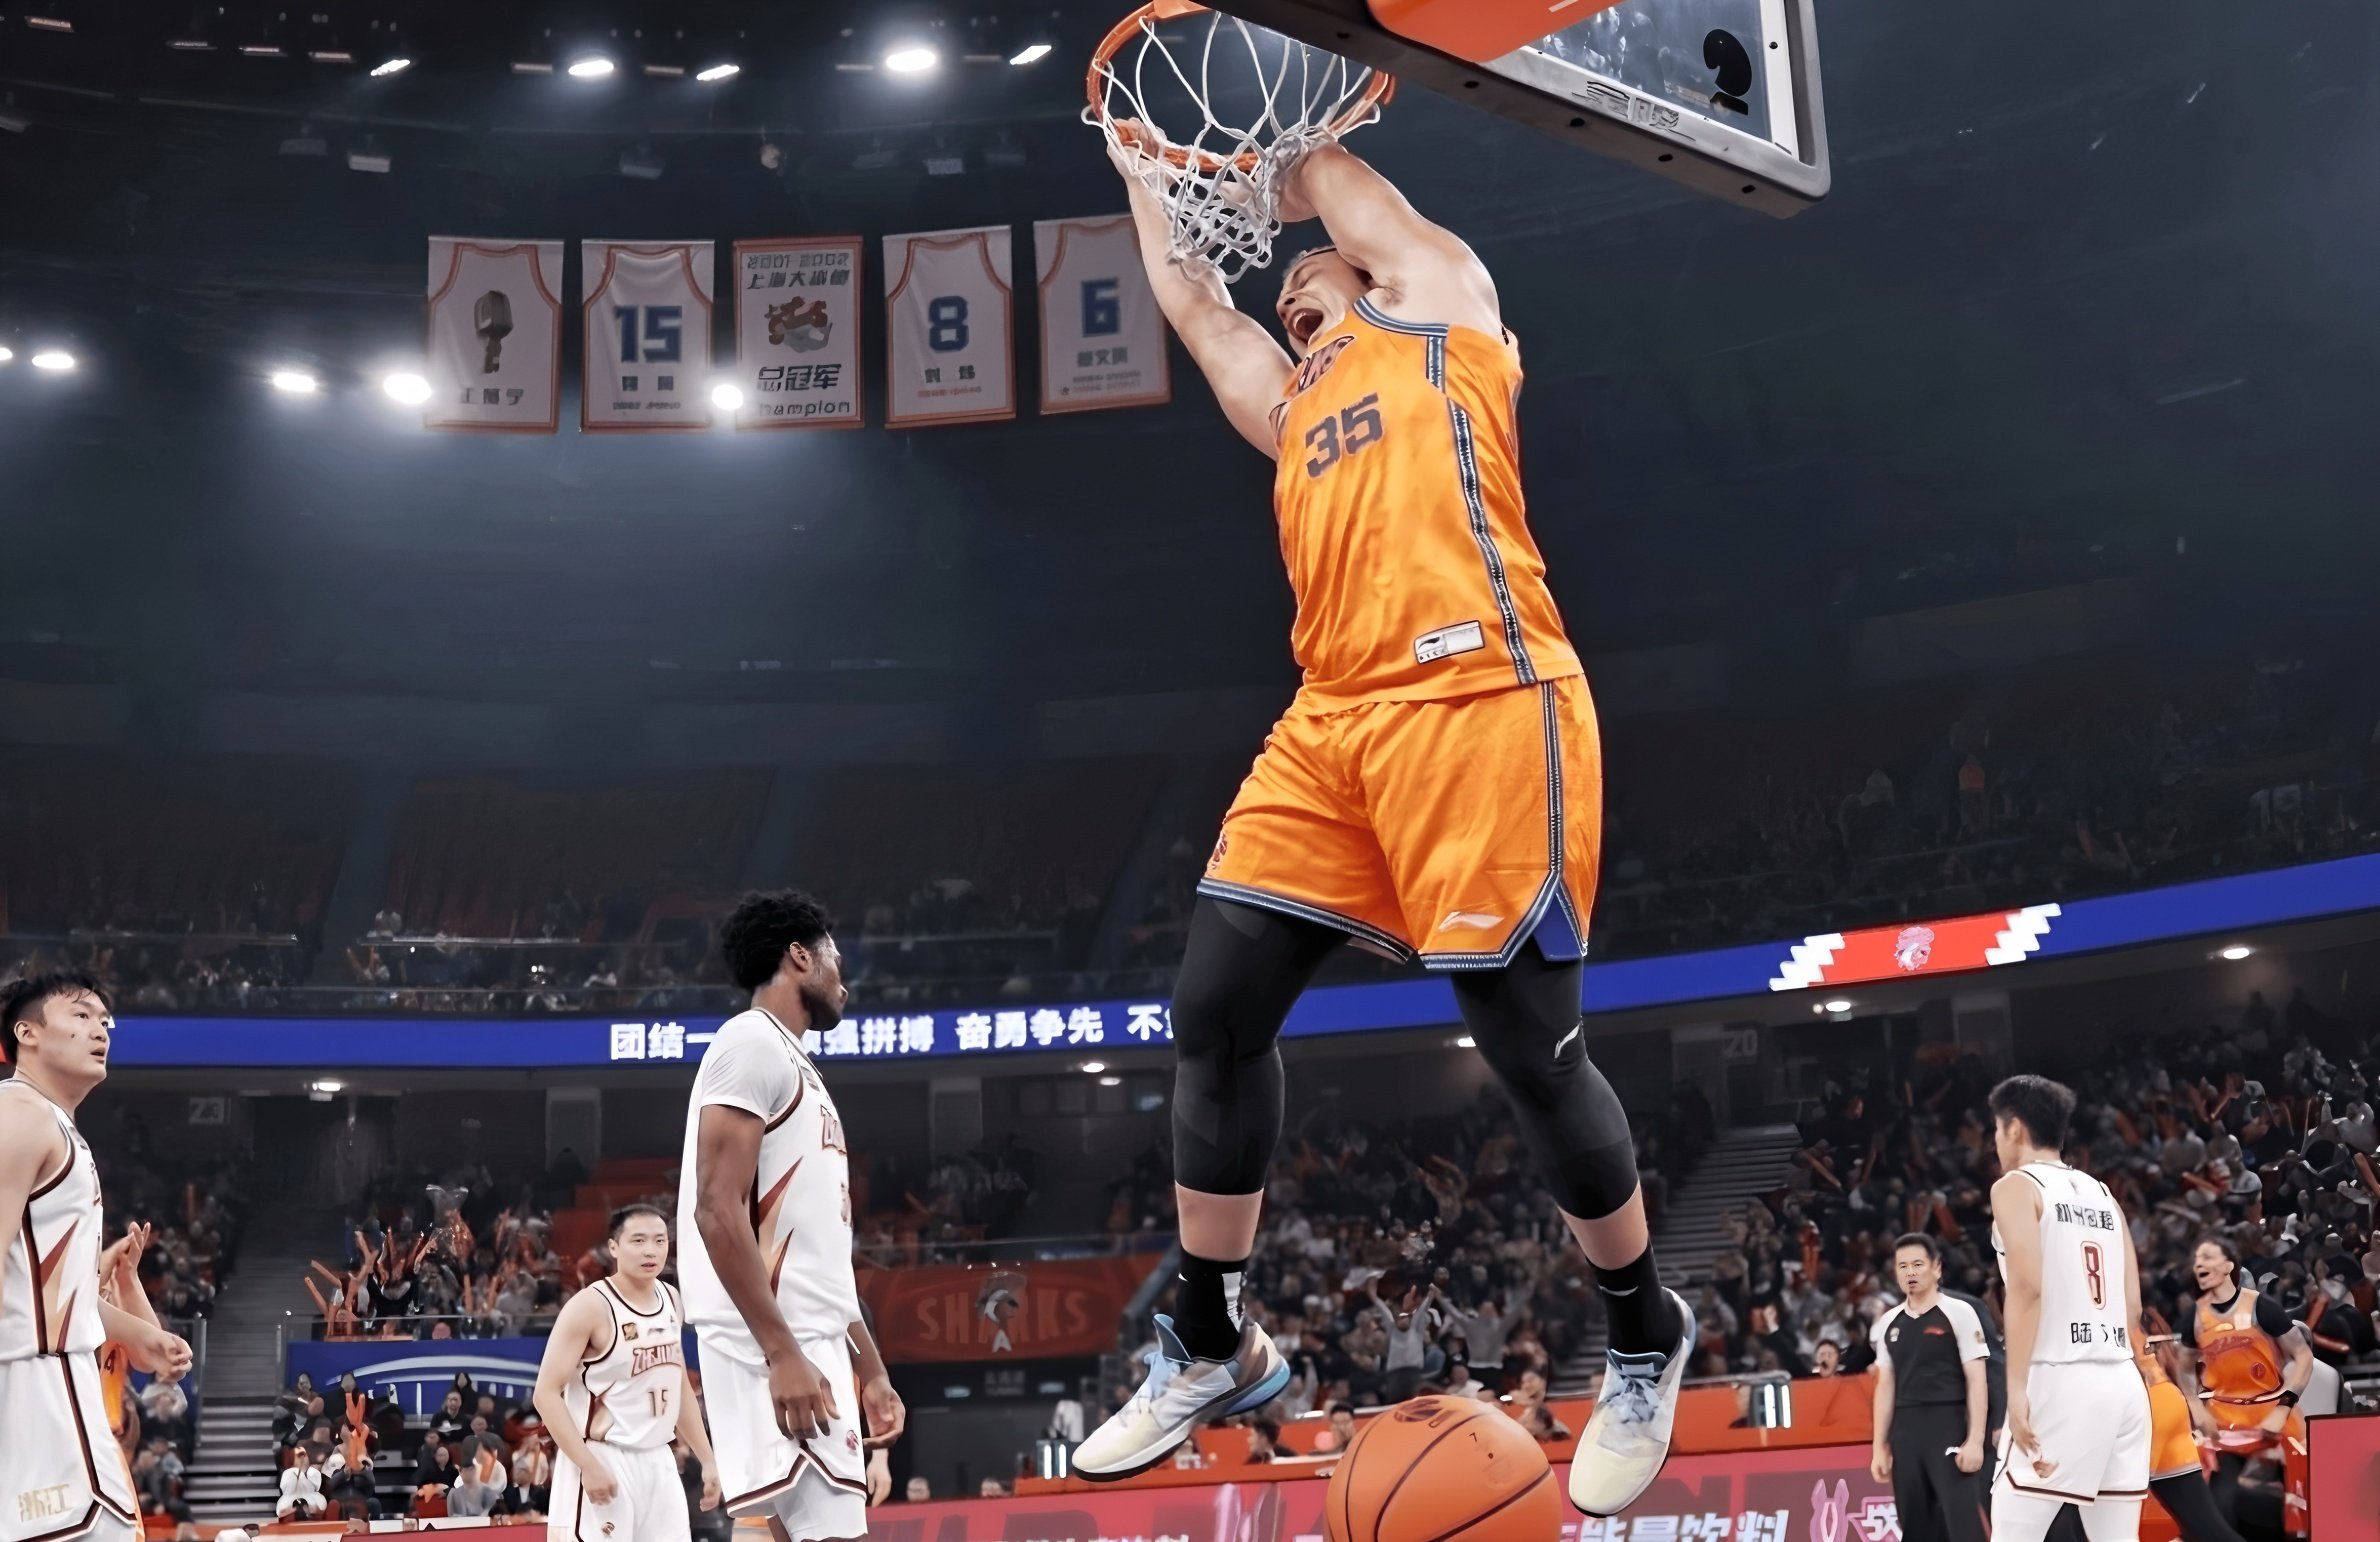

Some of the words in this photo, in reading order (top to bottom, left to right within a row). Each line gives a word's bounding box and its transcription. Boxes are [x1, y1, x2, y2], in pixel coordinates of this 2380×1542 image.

[614, 305, 682, 363] 15
[928, 295, 970, 353] 8
[1080, 277, 1121, 338] 6
[1305, 392, 1384, 478] 35
[954, 1006, 1104, 1050] 奋勇争先
[1126, 1004, 1174, 1041] 不
